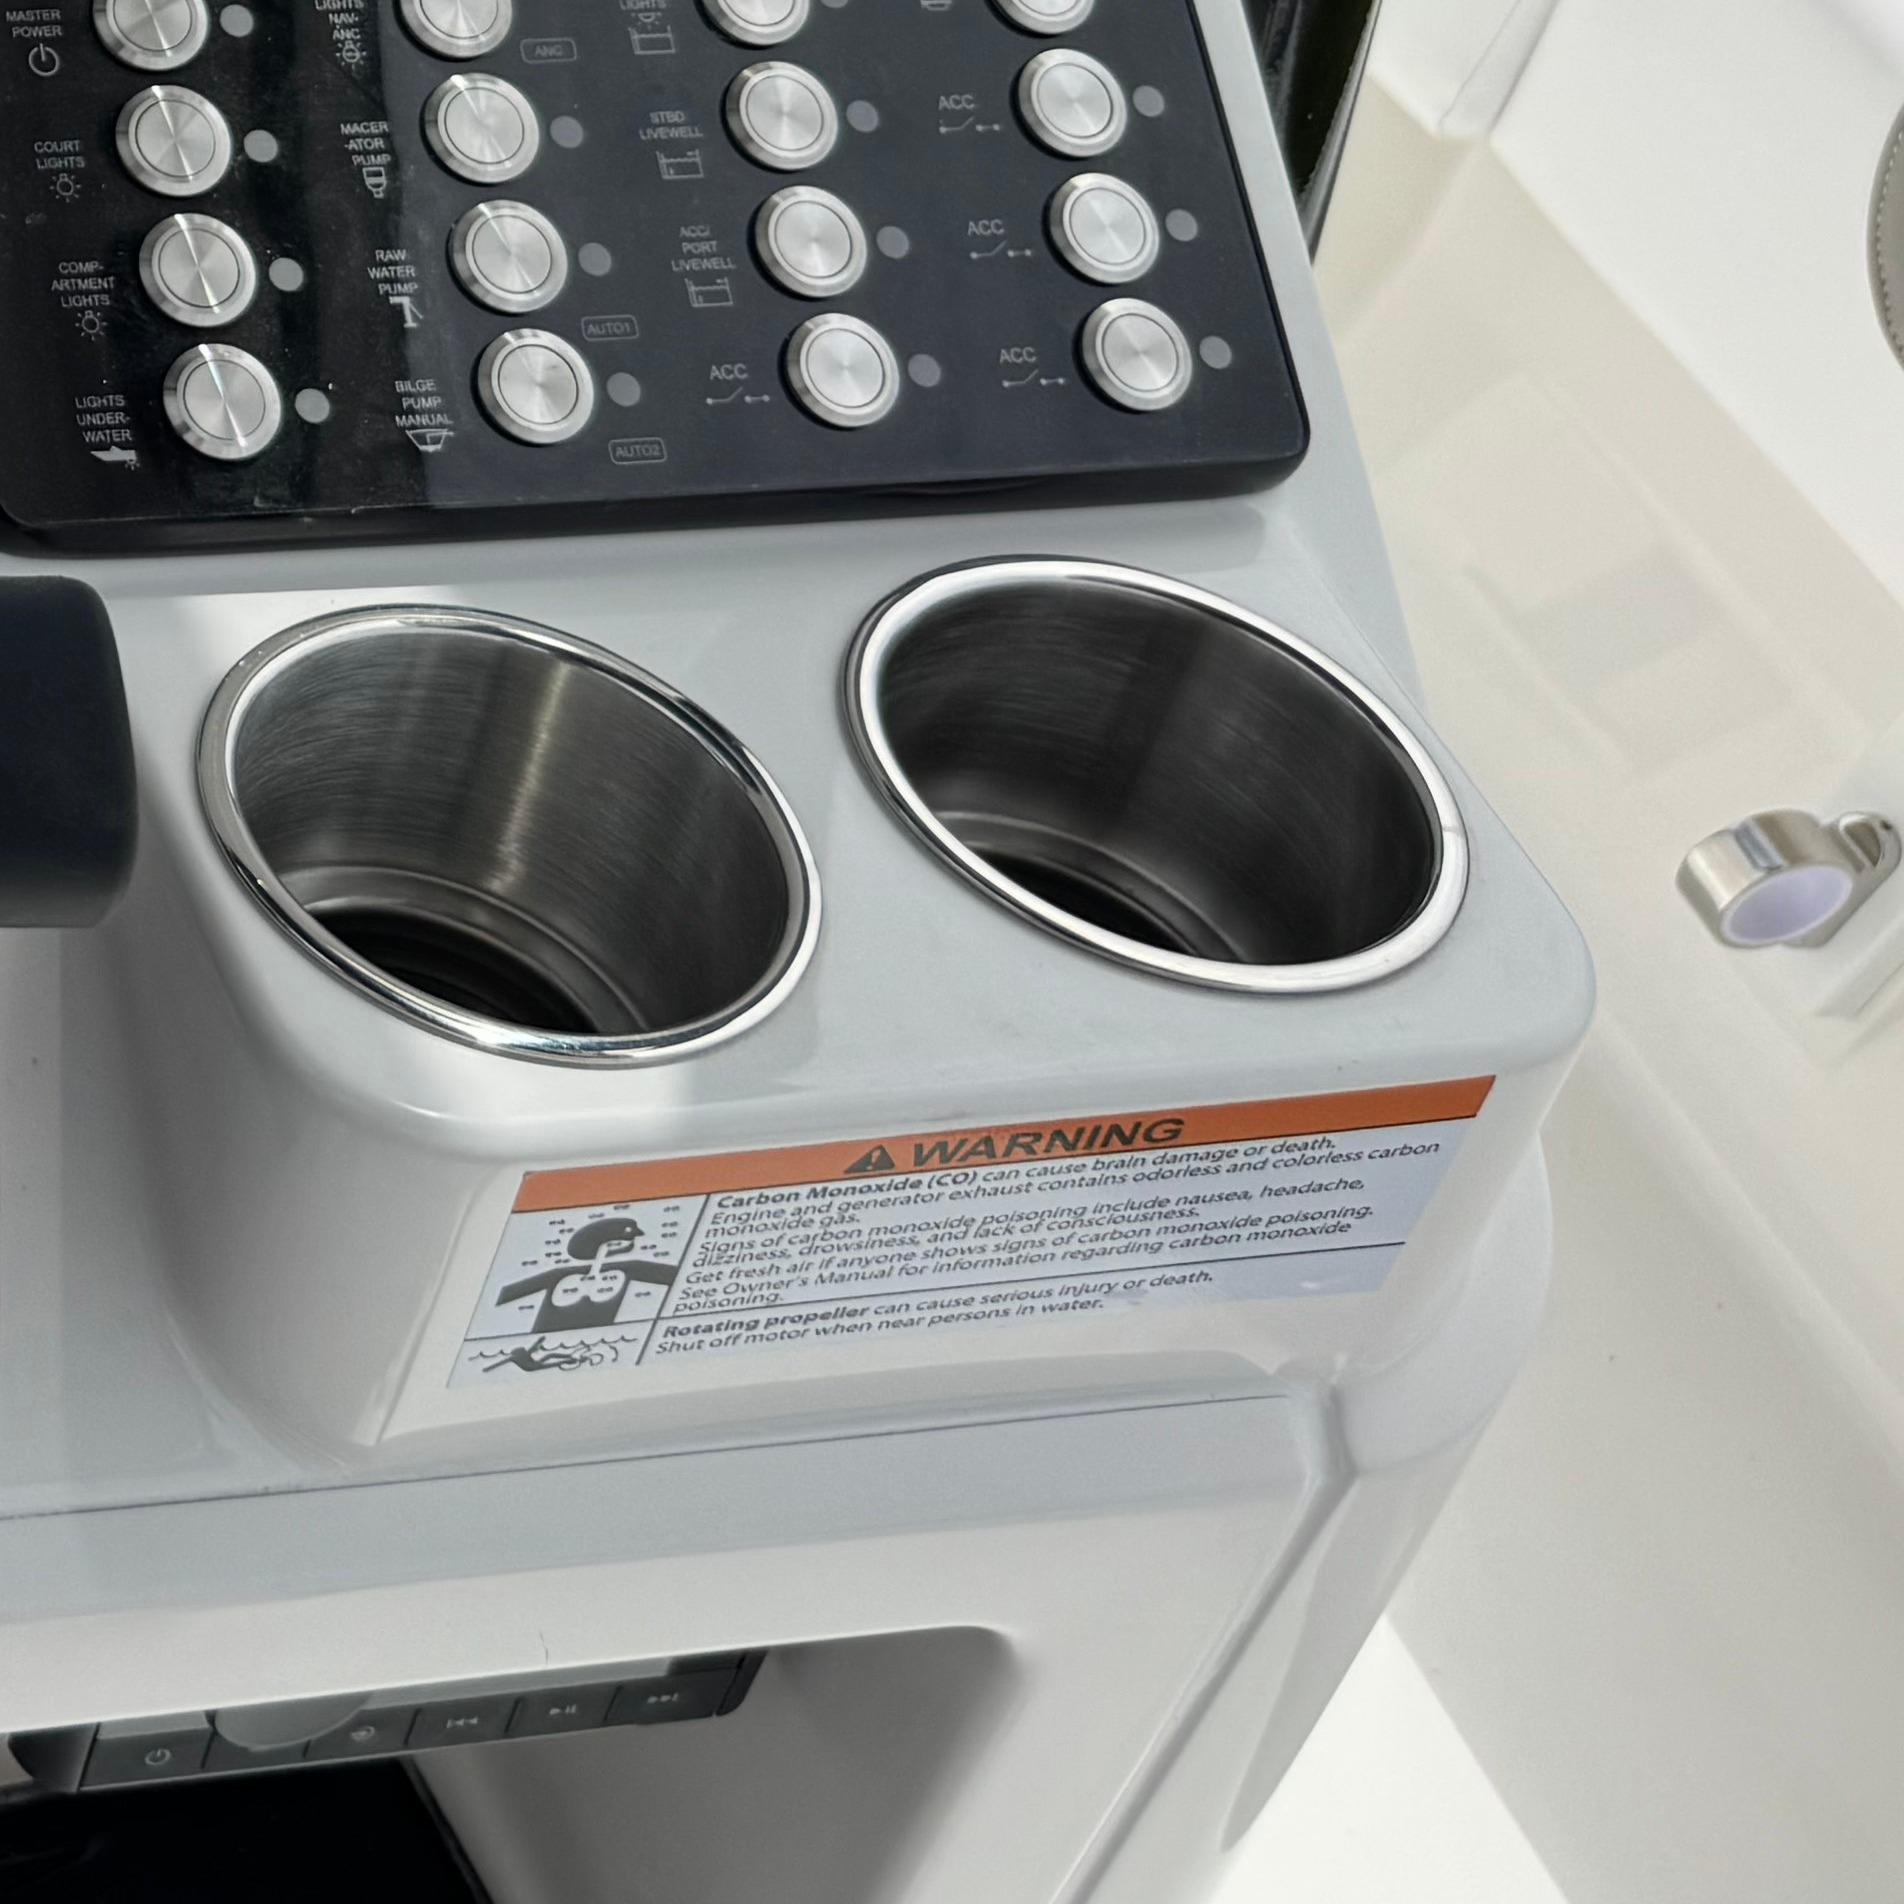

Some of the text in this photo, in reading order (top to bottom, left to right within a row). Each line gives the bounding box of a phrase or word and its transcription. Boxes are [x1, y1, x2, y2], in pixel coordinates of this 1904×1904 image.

[6, 8, 61, 22] MASTER
[12, 25, 63, 38] POWER
[332, 27, 360, 40] ANC
[938, 94, 975, 111] ACC
[649, 110, 686, 124] STBD
[340, 120, 389, 135] MACER
[639, 126, 703, 140] LIVEWELL
[34, 139, 80, 153] COURT
[36, 156, 85, 169] LIGHTS
[352, 153, 391, 166] PUMP
[967, 219, 1005, 236] ACC
[681, 240, 718, 254] PORT
[375, 249, 407, 262] RAW
[58, 260, 104, 274] COMP-
[671, 257, 736, 272] LIVEWELL
[368, 265, 416, 279] WATER
[51, 276, 115, 291] ARTMENT
[378, 282, 418, 295] PUMP
[61, 294, 110, 307] LIGHTS
[587, 322, 632, 335] AUTO1
[999, 347, 1036, 364] ACC
[709, 363, 749, 380] ACC
[395, 379, 436, 393] BILGE
[75, 395, 125, 408] LIGHTS
[402, 397, 442, 410] PUMP
[76, 411, 130, 426] UNDER-
[395, 413, 453, 427] MANUAL
[83, 429, 132, 443] WATER
[913, 1118, 1185, 1167] WARNING
[717, 1136, 1337, 1209] Carbon Monoxide (CO) can cause brain damage or death.
[710, 1141, 1440, 1227] Engine and generator exhaust contains odorless and colorless carbon
[698, 1177, 1365, 1256] Signs of carbon monoxide poisoning include nausea, headache,
[704, 1213, 860, 1239] monoxide gas.
[685, 1205, 1373, 1285] Get fresh air if anyone shows signs of carbon monoxide poisoning.
[692, 1207, 1200, 1269] dizziness, drowsiness, and lack of consciousness.
[678, 1285, 720, 1301] See
[814, 1267, 894, 1287] Manual
[897, 1263, 928, 1279] for
[932, 1251, 1056, 1274] information
[1060, 1240, 1164, 1262] regarding
[1168, 1232, 1241, 1250] carbon
[1245, 1221, 1352, 1242] monoxide
[662, 1270, 1214, 1339] Rotating propeller can cause serious injury or death.
[673, 1292, 784, 1316] poisoning.
[655, 1297, 1104, 1355] Shut off motor when near persons in water.
